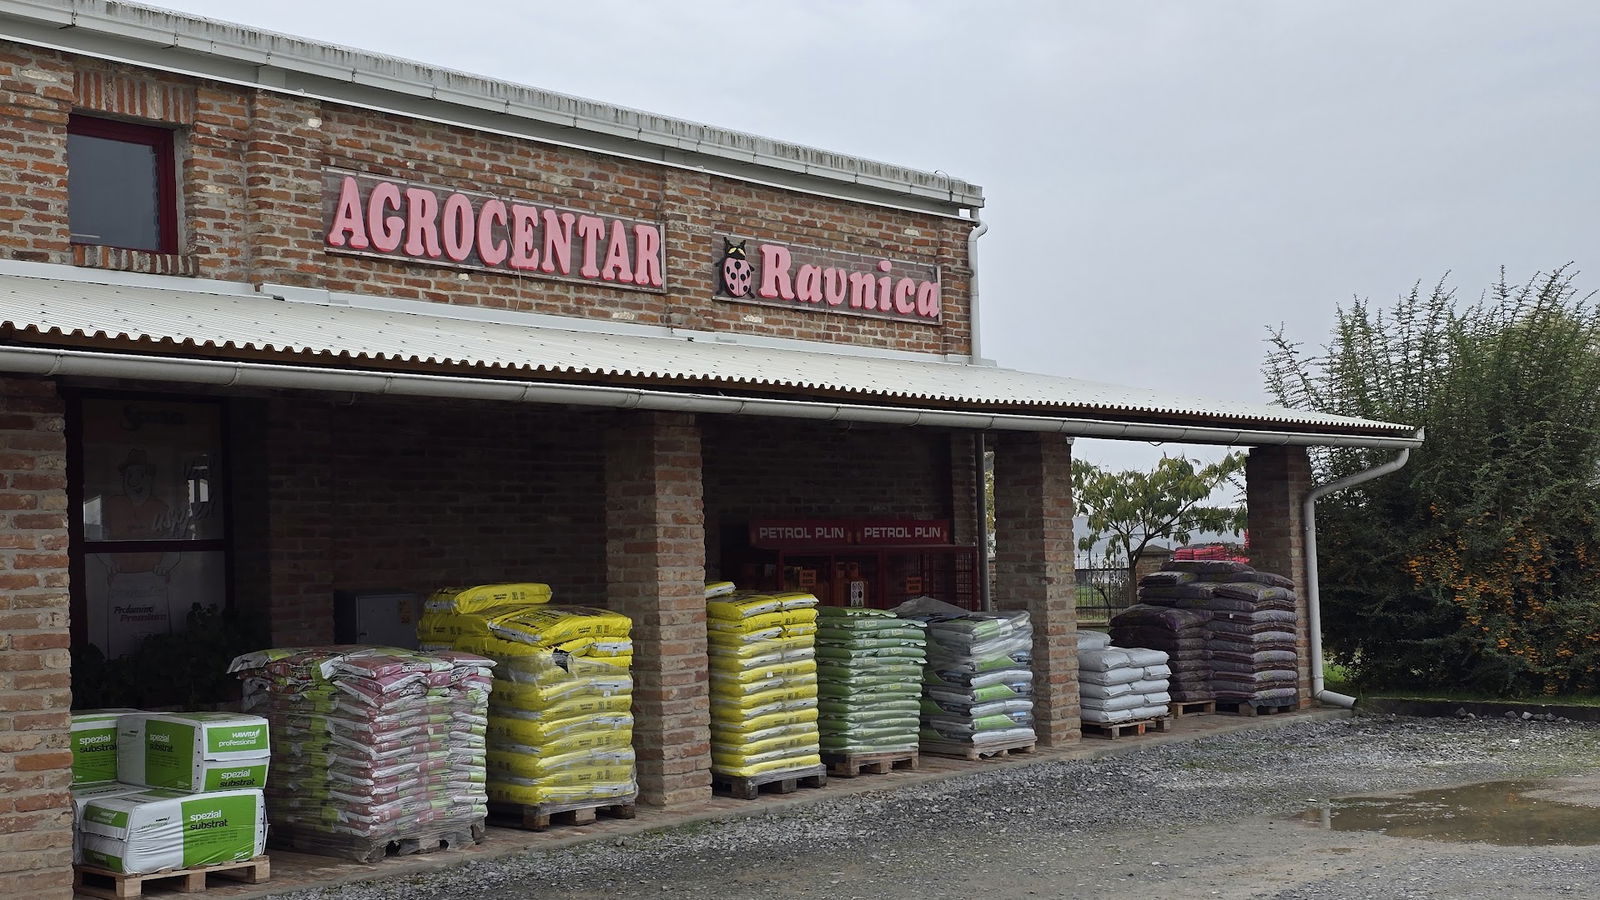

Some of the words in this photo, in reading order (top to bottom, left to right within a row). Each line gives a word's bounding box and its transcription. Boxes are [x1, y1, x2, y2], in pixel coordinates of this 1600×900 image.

[327, 176, 663, 286] AGROCENTAR
[758, 244, 940, 318] Ravnica
[759, 527, 812, 539] PETROL
[815, 527, 845, 539] PLIN
[864, 526, 911, 538] PETROL
[914, 526, 941, 538] PLIN
[79, 734, 111, 746] spezial
[218, 738, 256, 748] professional
[220, 769, 251, 780] spezial
[219, 778, 255, 788] substrat
[190, 809, 222, 822] spezial
[189, 819, 228, 831] substrat
